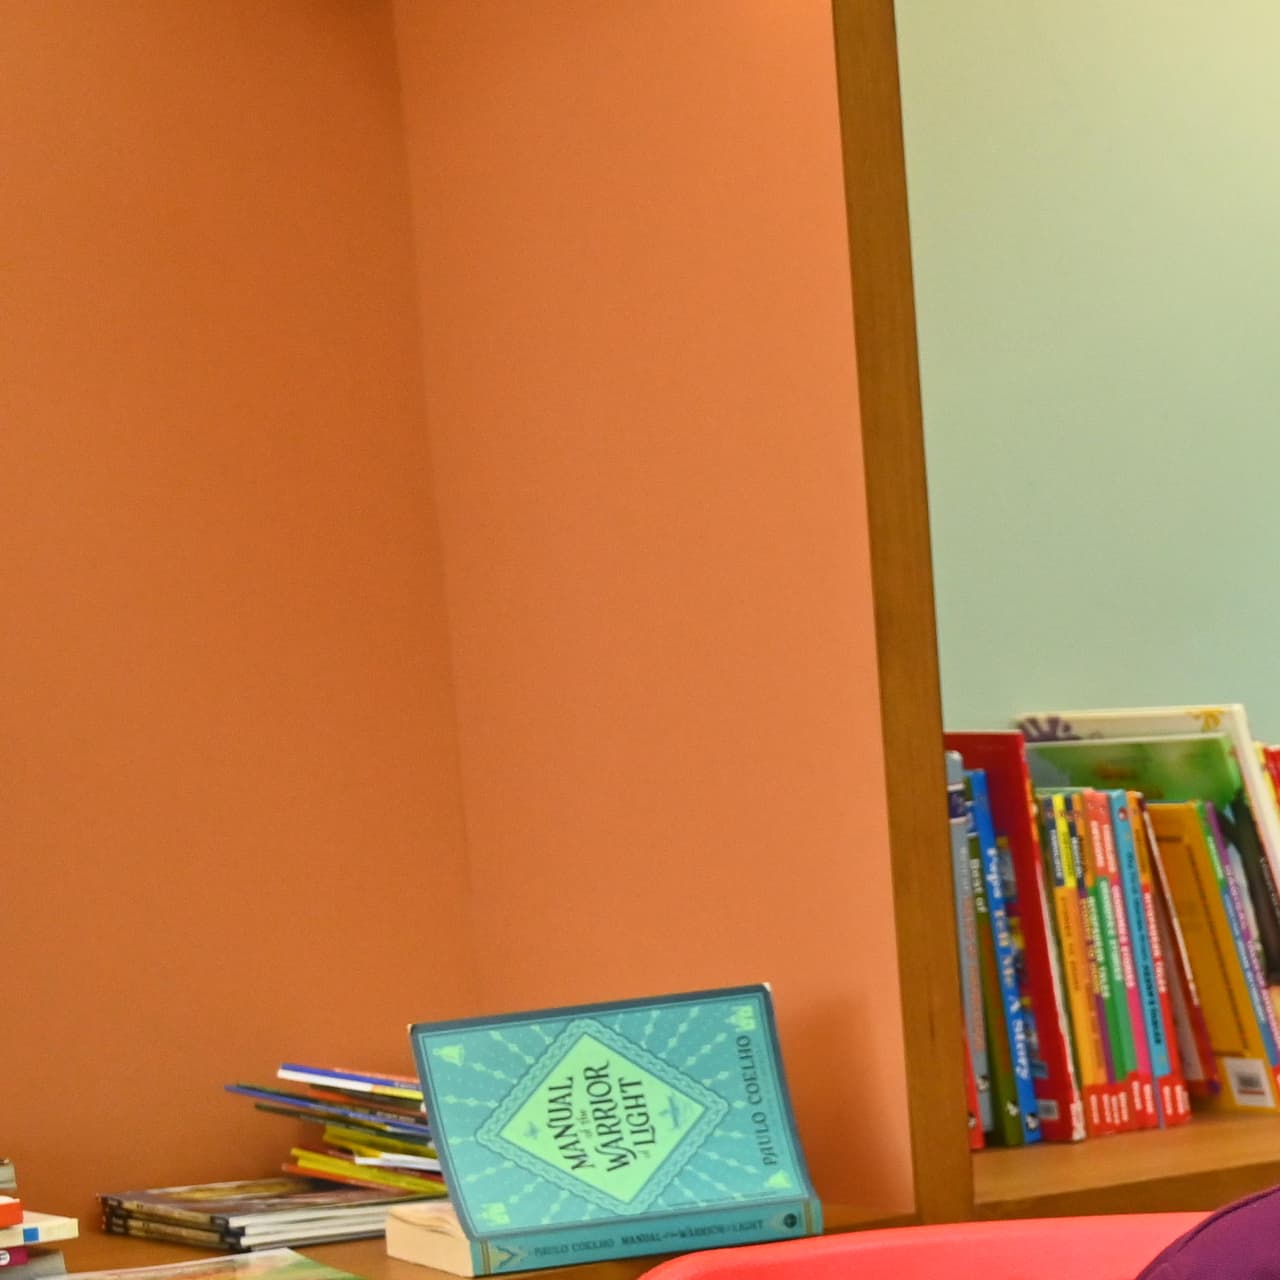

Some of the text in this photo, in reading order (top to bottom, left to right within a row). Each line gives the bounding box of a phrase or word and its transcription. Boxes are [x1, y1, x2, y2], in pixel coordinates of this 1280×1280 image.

[970, 858, 983, 894] Best
[976, 897, 987, 913] of
[1009, 996, 1021, 1013] A
[1013, 1019, 1030, 1079] Story
[547, 1076, 596, 1172] MANUAL
[583, 1060, 638, 1173] WARRIOR
[617, 1076, 656, 1147] LIGHT
[737, 1035, 777, 1166] PAULO COELHO
